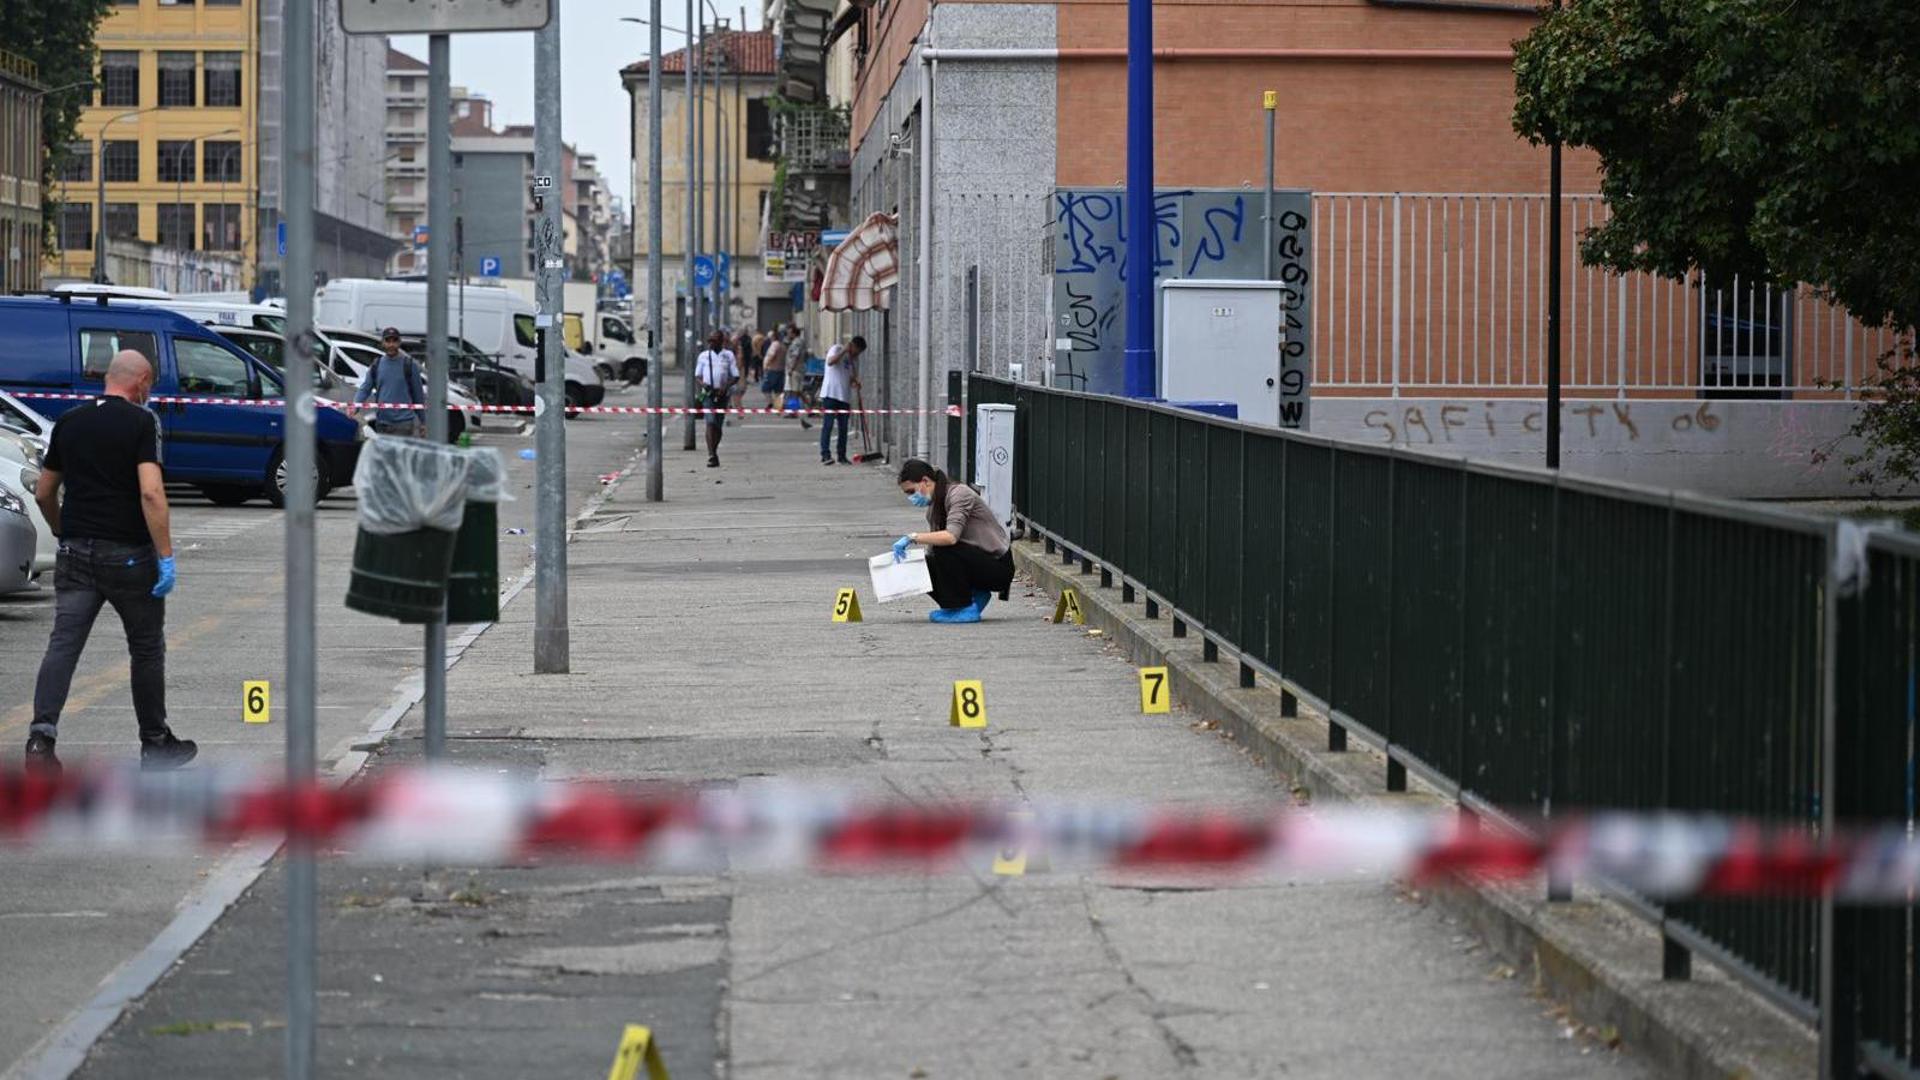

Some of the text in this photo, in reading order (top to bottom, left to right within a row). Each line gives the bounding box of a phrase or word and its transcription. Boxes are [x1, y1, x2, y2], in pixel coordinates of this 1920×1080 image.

[770, 232, 816, 250] BAR
[483, 258, 497, 276] P
[836, 592, 850, 615] 5
[1069, 592, 1080, 615] 4
[248, 686, 265, 714] 6
[1145, 673, 1164, 704] 7
[962, 687, 980, 718] 8
